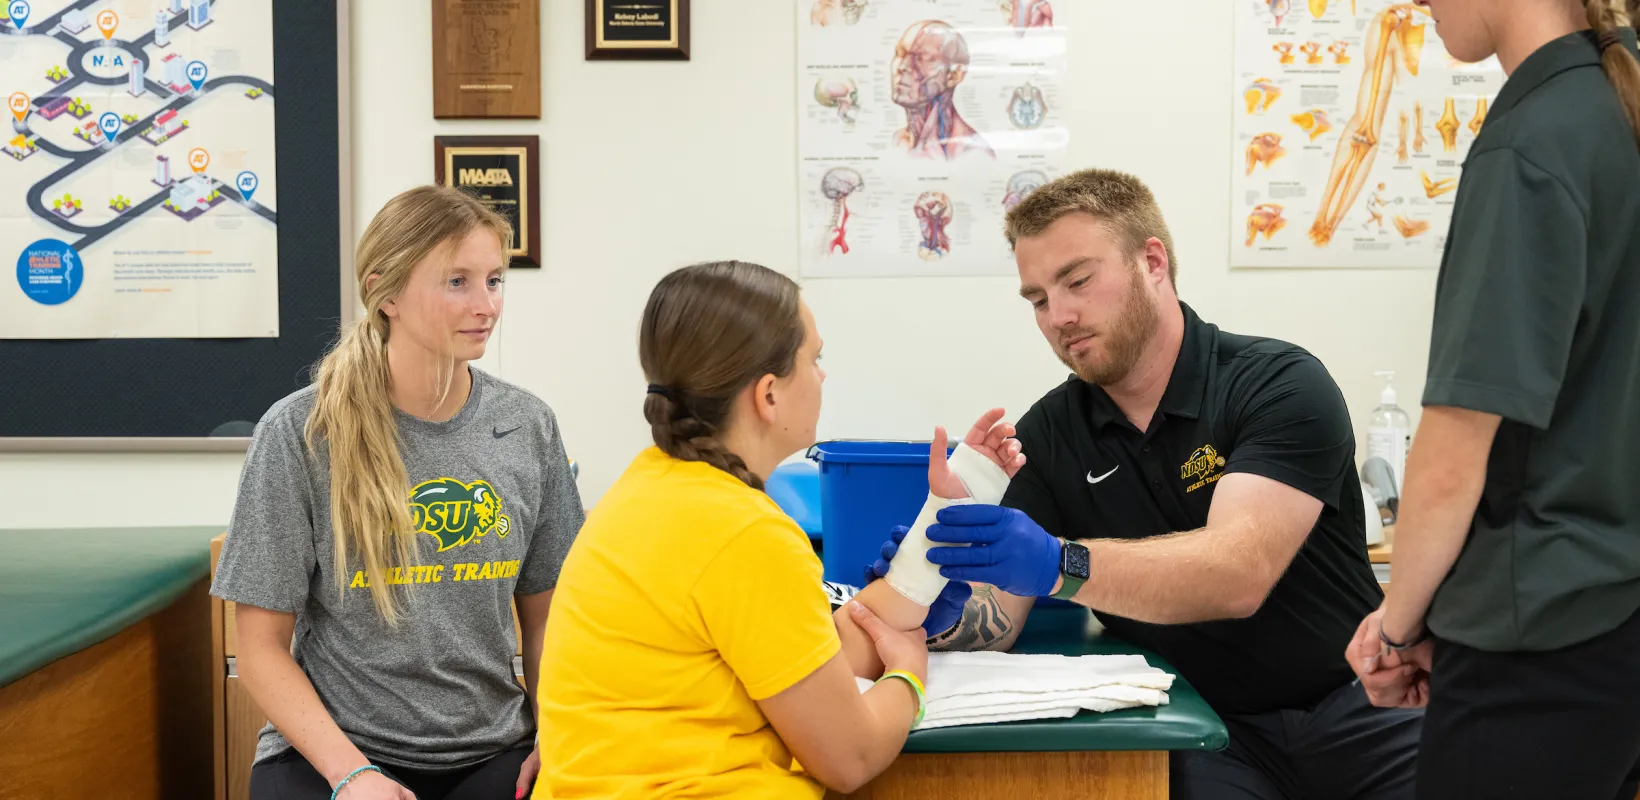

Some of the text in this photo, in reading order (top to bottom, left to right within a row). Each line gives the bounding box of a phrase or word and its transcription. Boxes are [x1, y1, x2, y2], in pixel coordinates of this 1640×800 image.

[13, 6, 26, 14] AT
[92, 55, 124, 67] NA
[190, 67, 203, 76] AT
[105, 119, 118, 128] AT
[241, 177, 254, 186] AT
[459, 167, 513, 187] MAATA
[1205, 472, 1223, 483] TRAIN
[406, 501, 472, 533] DSU
